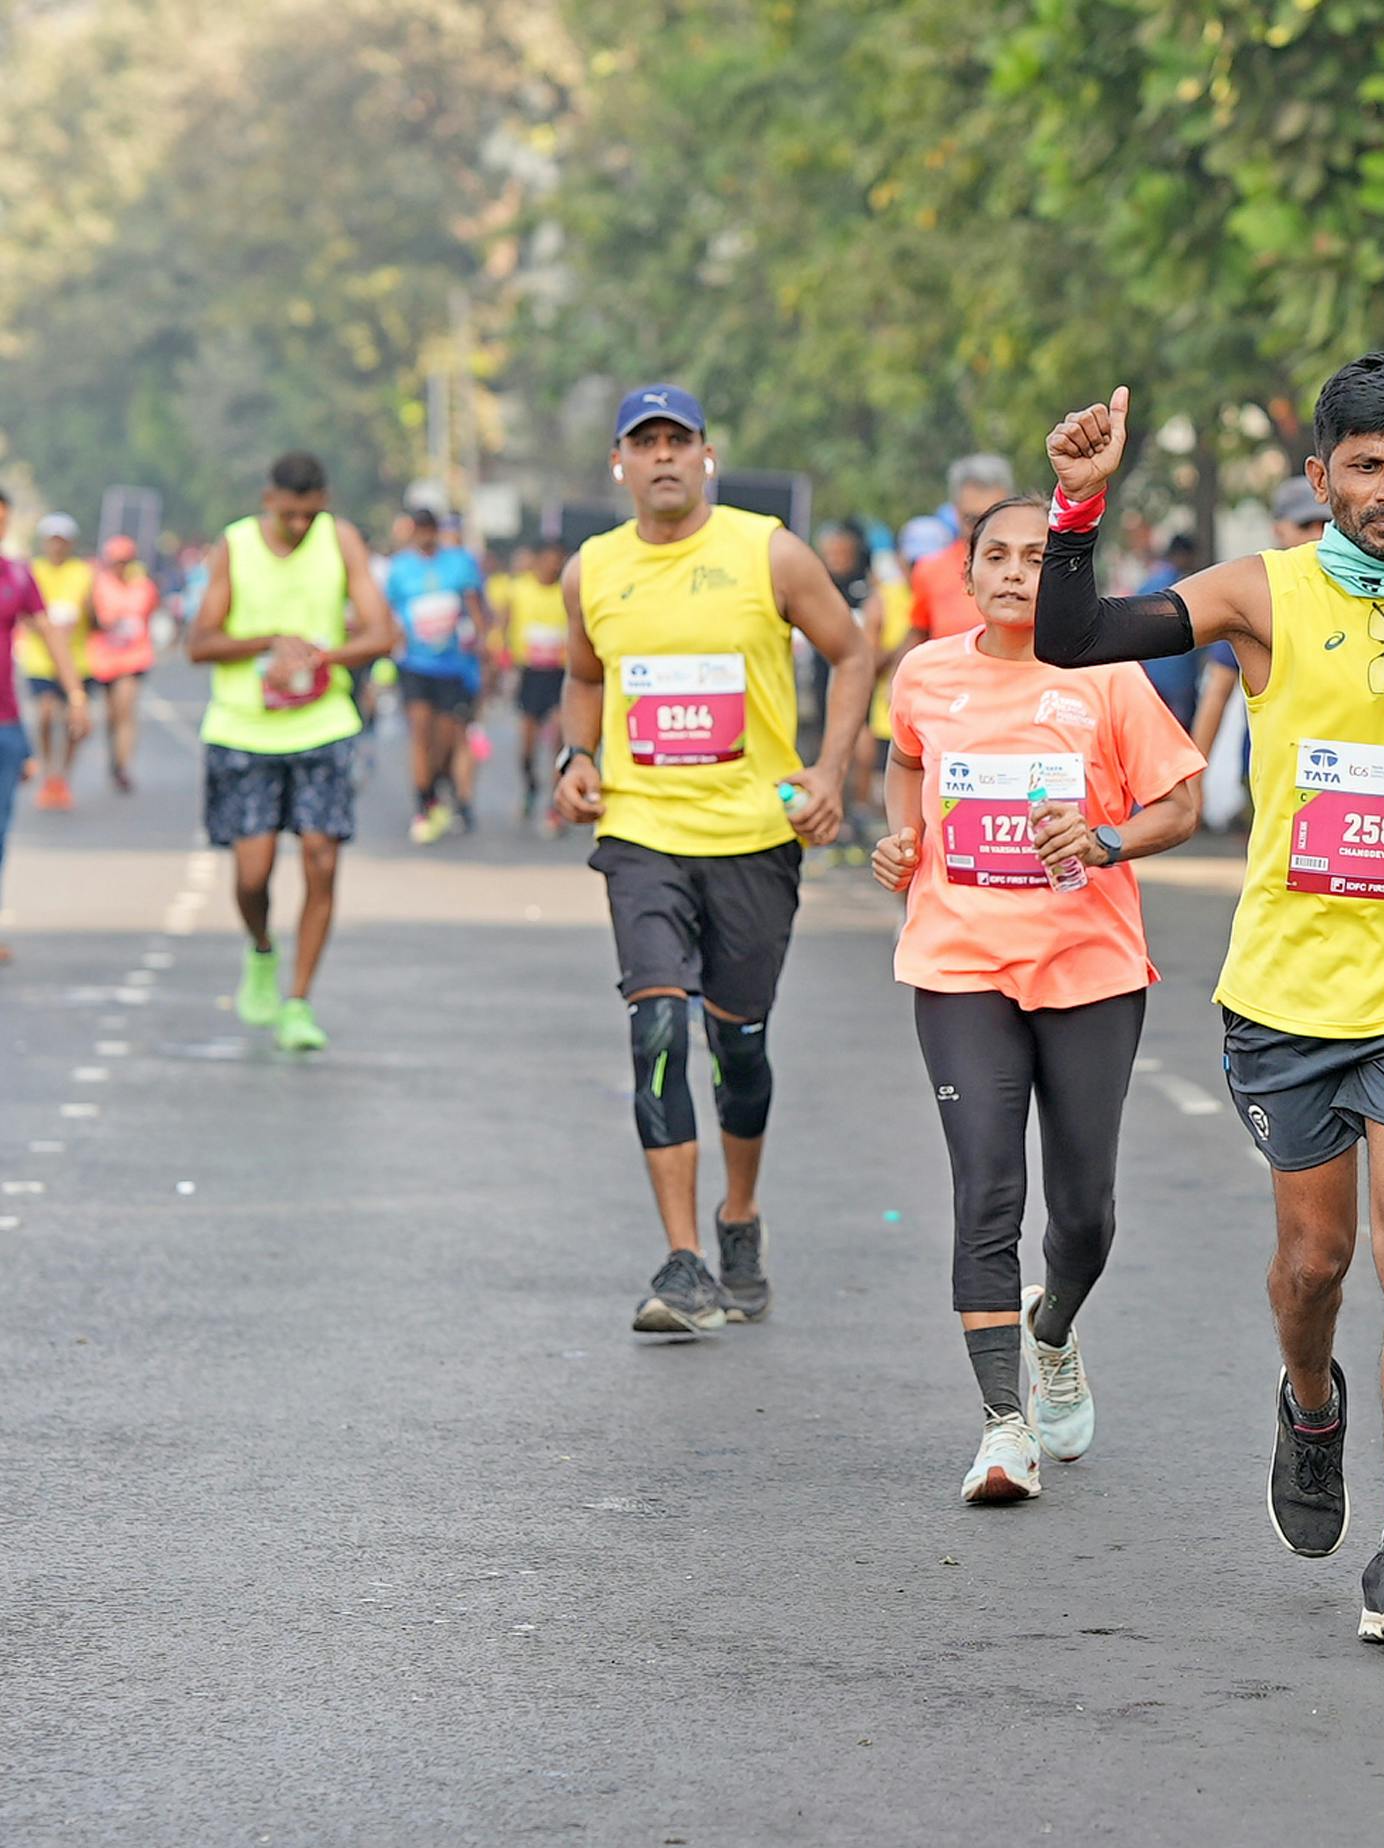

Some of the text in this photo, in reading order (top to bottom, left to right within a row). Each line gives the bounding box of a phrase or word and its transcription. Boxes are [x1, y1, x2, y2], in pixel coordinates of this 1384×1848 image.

[1303, 770, 1341, 783] TATA
[945, 782, 974, 792] TATA
[1346, 881, 1367, 891] IDFC
